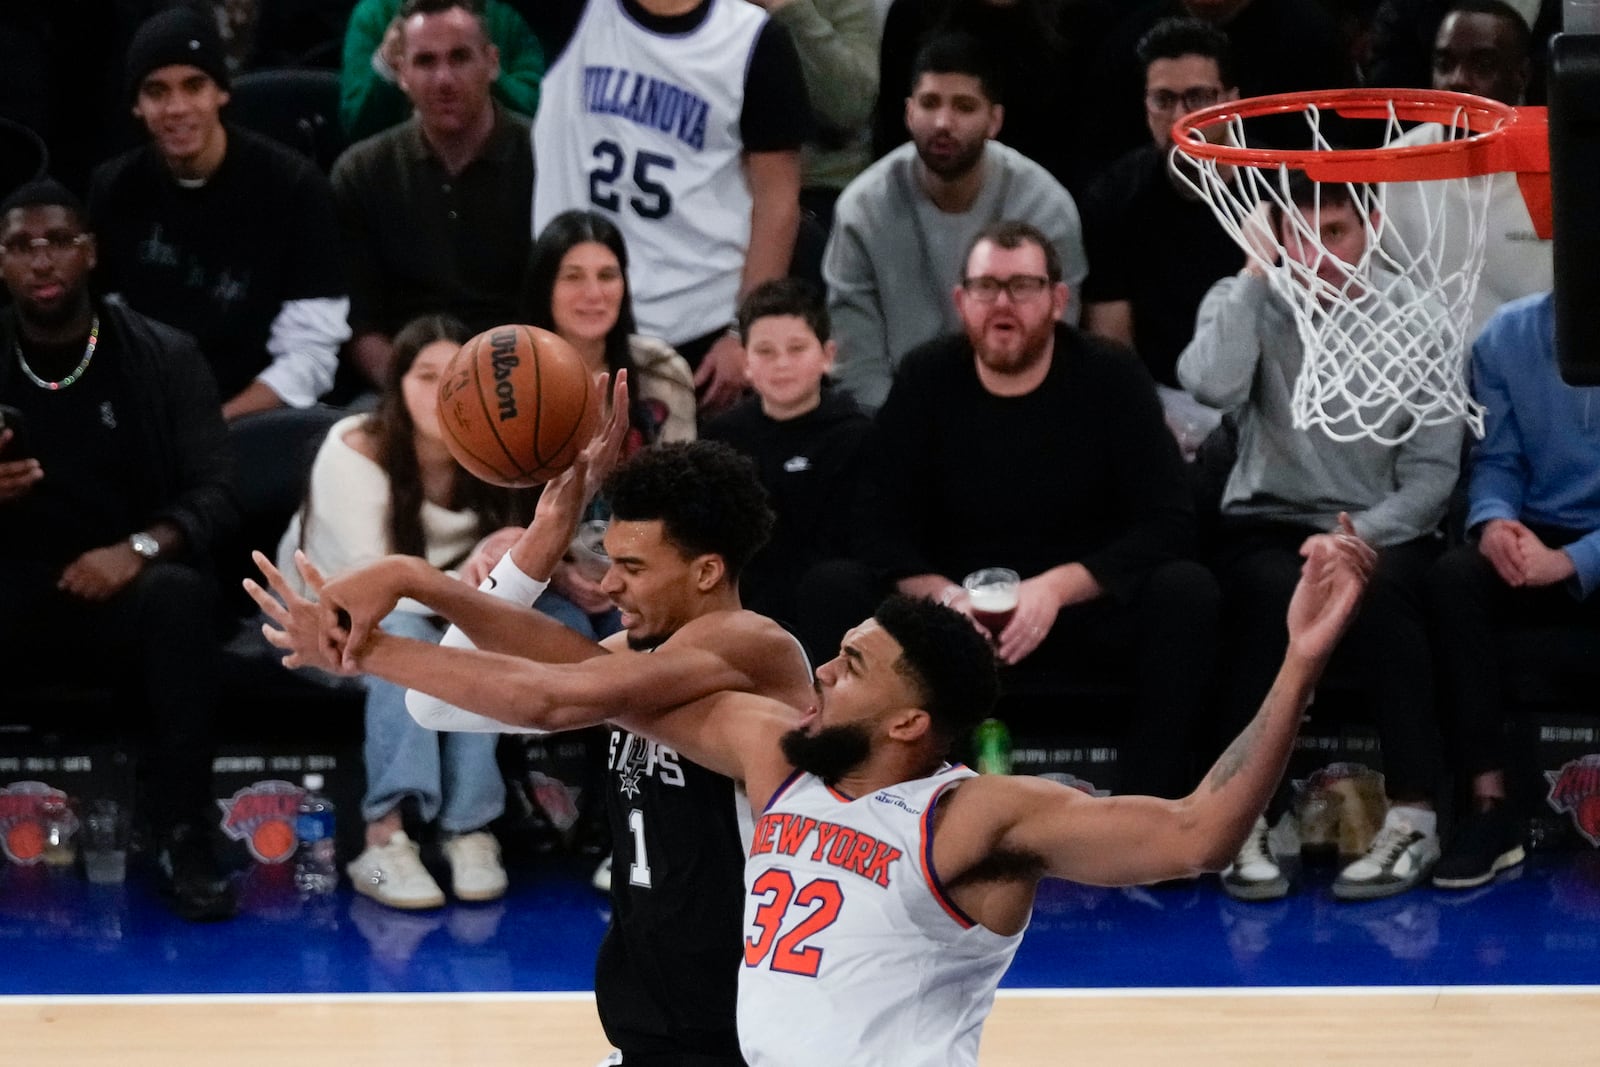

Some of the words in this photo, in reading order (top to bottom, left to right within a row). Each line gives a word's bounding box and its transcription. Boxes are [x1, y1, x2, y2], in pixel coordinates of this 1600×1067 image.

[583, 65, 711, 153] VILLANOVA
[589, 138, 676, 220] 25
[490, 327, 520, 422] Wilson
[628, 808, 652, 889] 1
[749, 812, 816, 858] NEW
[810, 820, 904, 890] YORK
[744, 866, 845, 979] 32
